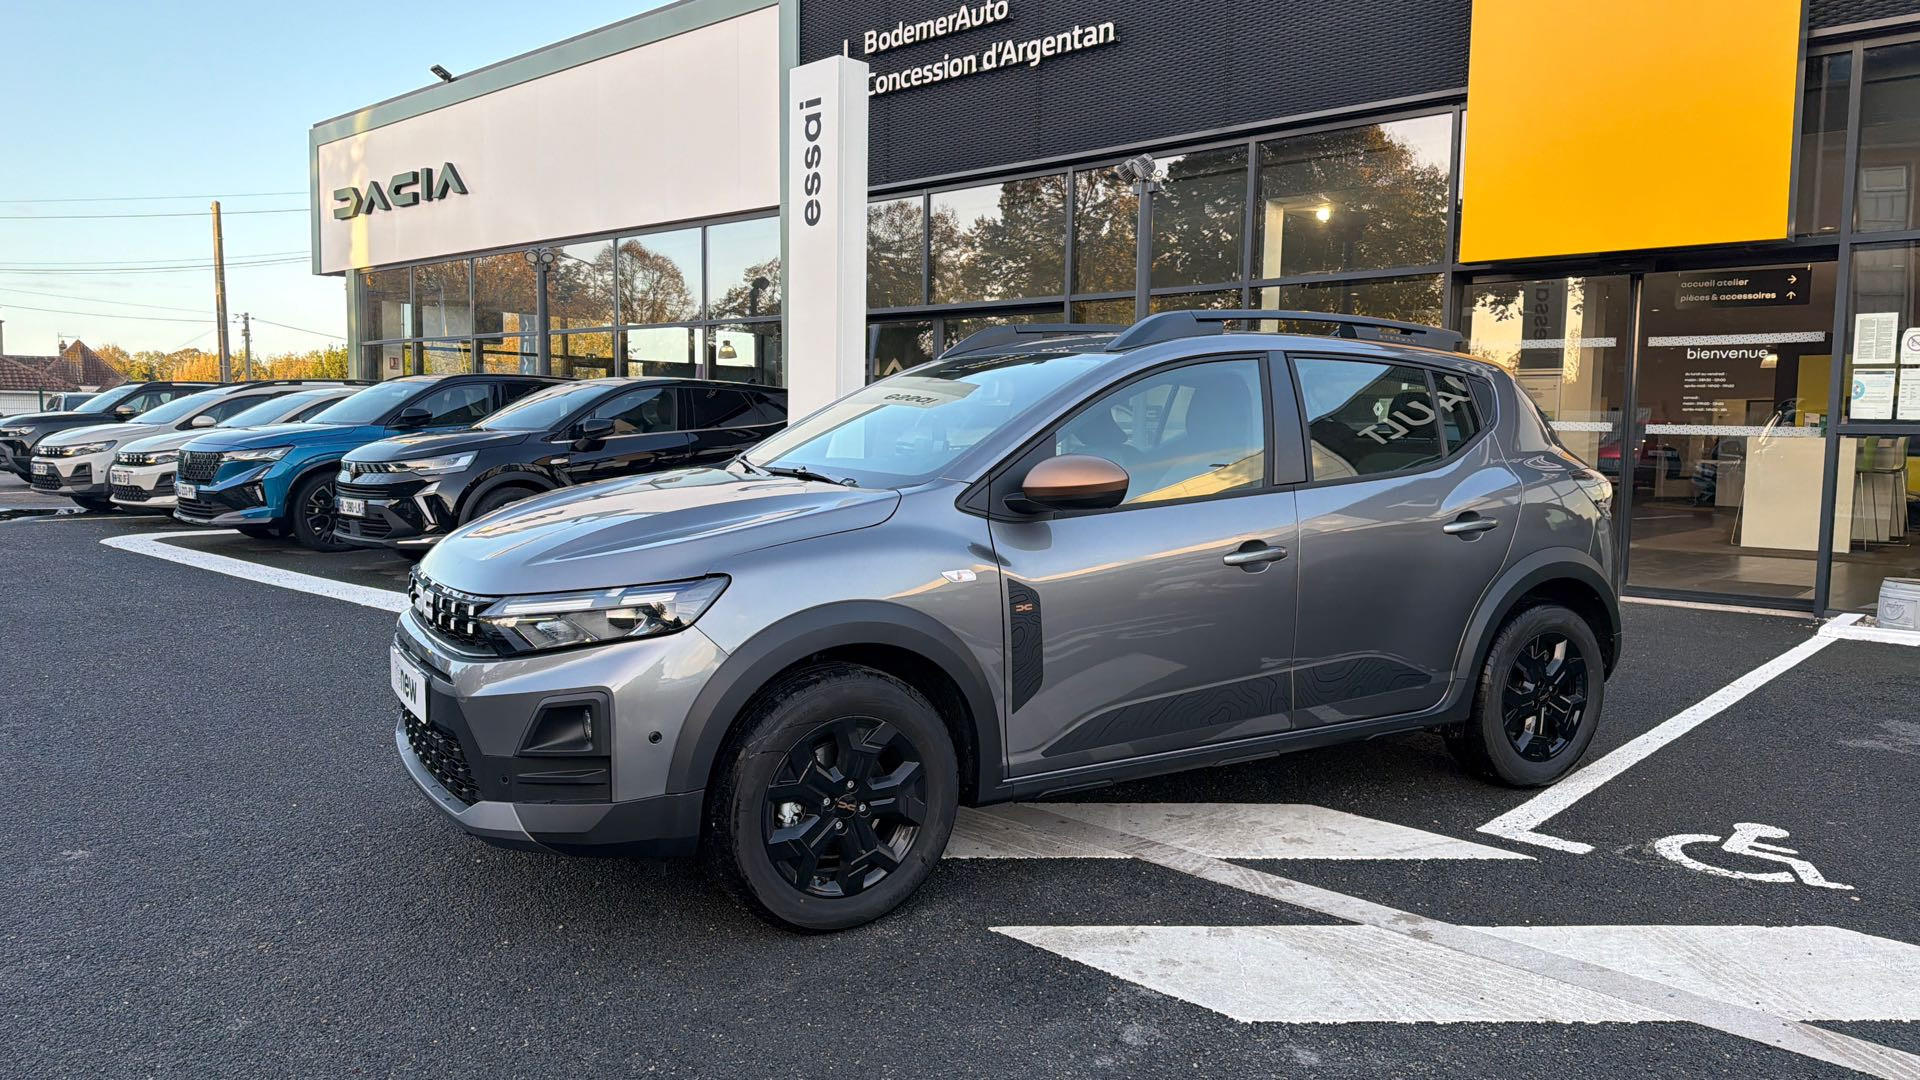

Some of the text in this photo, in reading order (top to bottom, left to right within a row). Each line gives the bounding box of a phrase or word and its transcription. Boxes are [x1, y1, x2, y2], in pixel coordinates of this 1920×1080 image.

[864, 0, 1009, 54] BodemerAuto
[868, 21, 1115, 96] Concession d'Argentan
[799, 97, 821, 226] essai
[333, 162, 469, 220] DACIA
[1681, 278, 1749, 288] accueil atelier
[1720, 291, 1777, 300] accessoires
[1686, 347, 1769, 360] bienvenue
